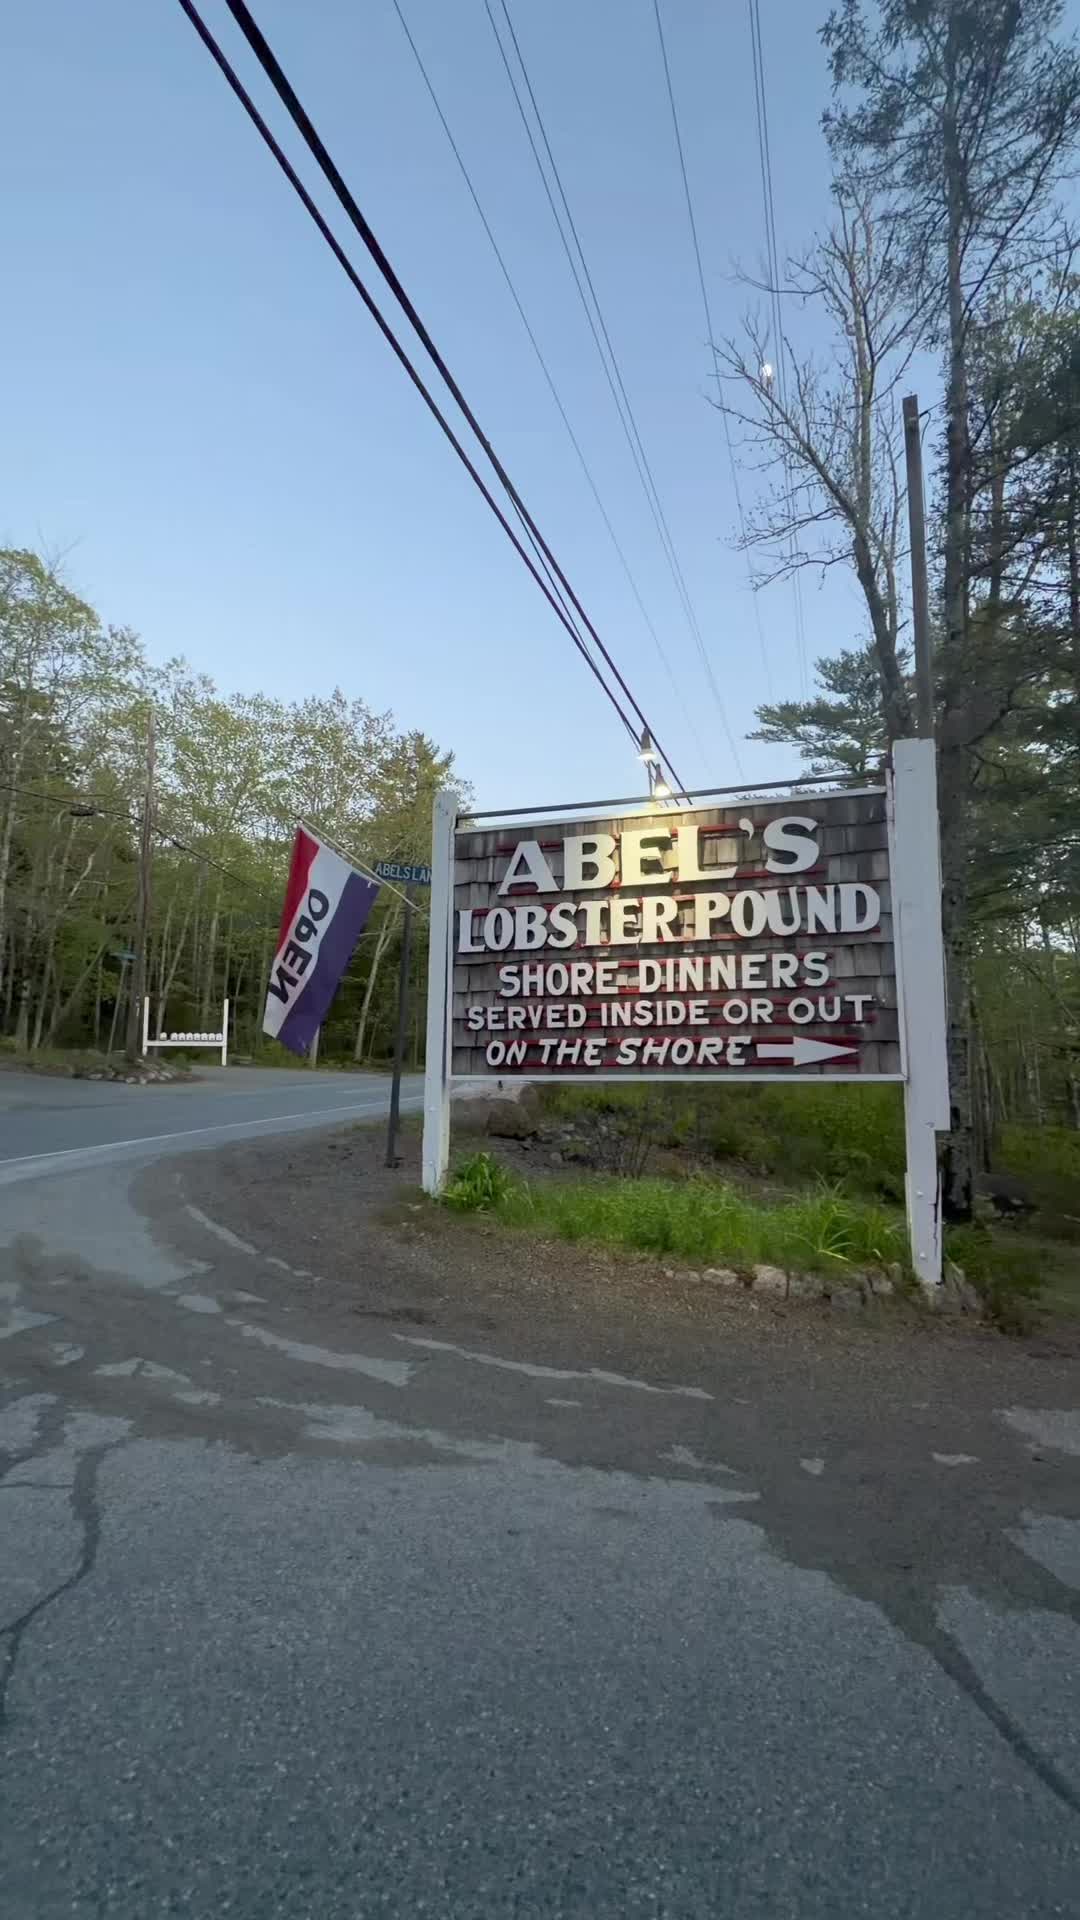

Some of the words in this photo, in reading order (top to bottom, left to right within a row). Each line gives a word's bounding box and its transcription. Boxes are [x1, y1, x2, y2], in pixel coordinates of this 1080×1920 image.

[375, 862, 410, 879] ABELS
[498, 816, 820, 896] ABEL'S
[458, 896, 679, 953] LOBSTER
[695, 882, 881, 941] POUND
[499, 961, 619, 998] SHORE
[638, 952, 830, 994] DINNERS
[467, 1003, 587, 1031] SERVED
[601, 1000, 709, 1026] INSIDE
[722, 998, 775, 1024] OR
[787, 995, 873, 1024] OUT
[486, 1040, 528, 1066] ON
[538, 1038, 606, 1065] THE
[616, 1035, 752, 1066] SHORE
